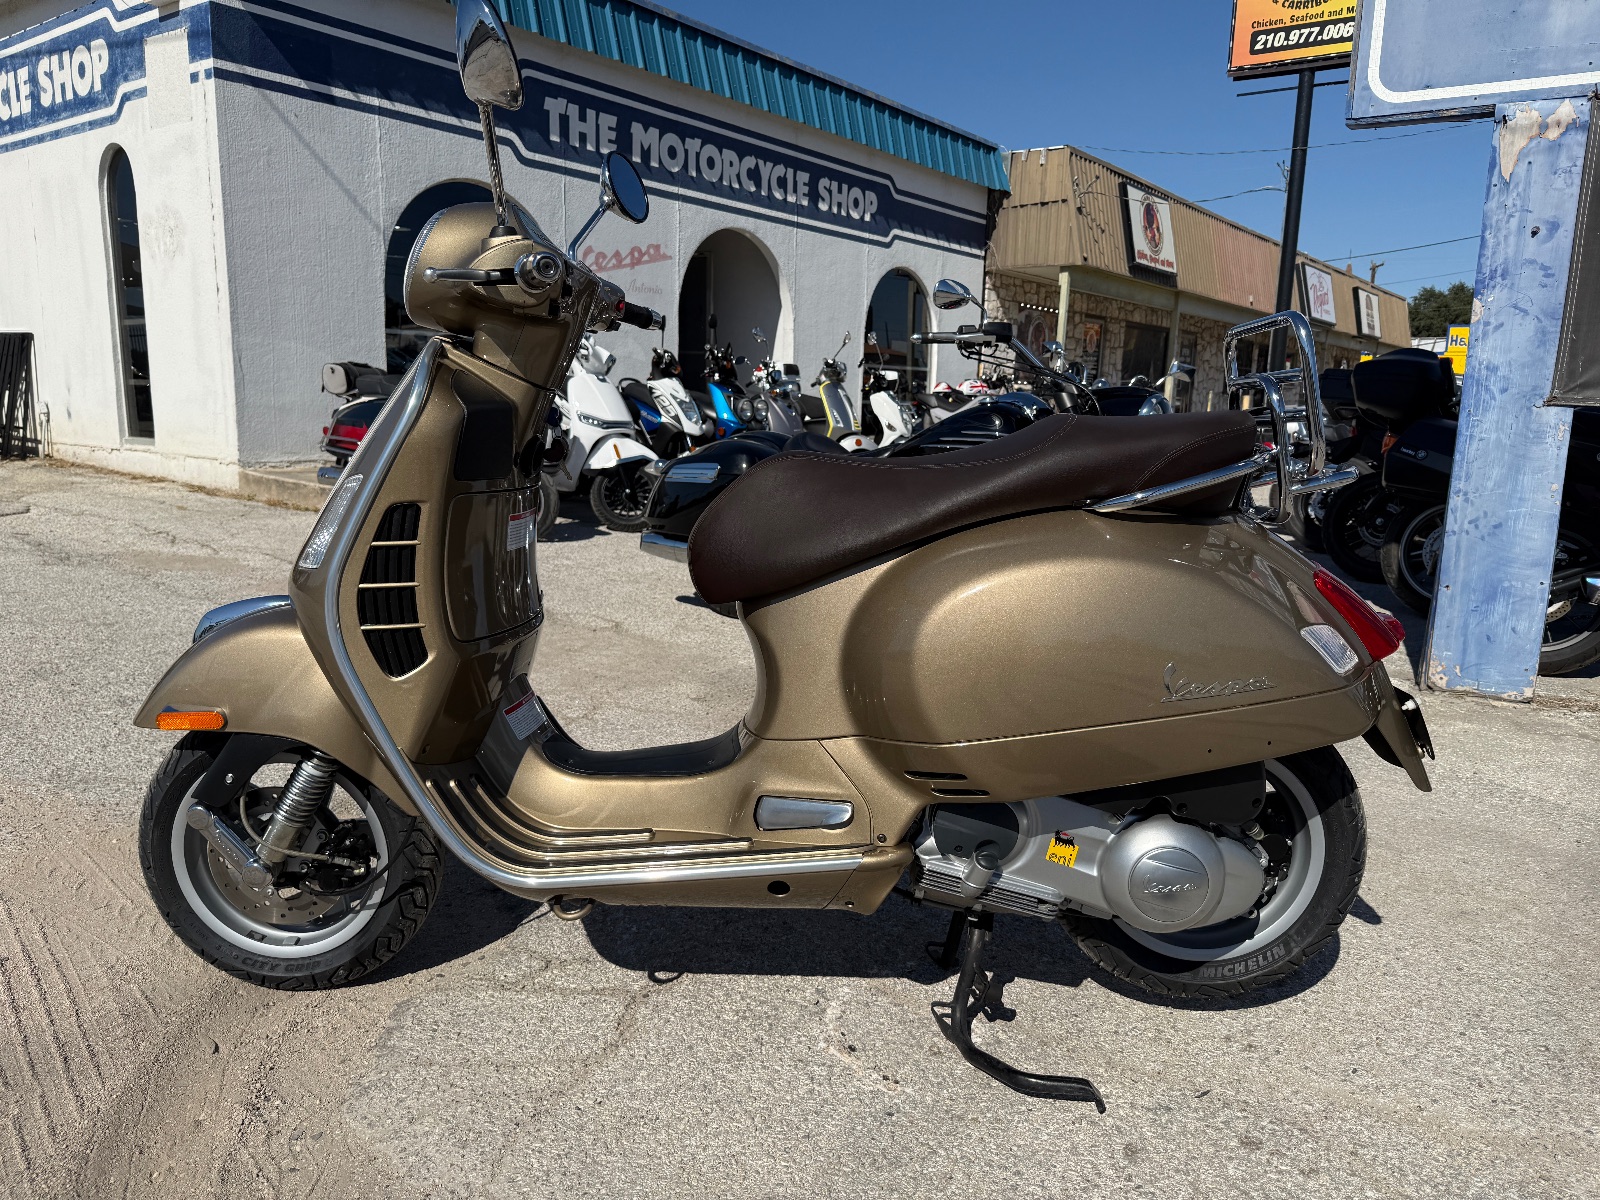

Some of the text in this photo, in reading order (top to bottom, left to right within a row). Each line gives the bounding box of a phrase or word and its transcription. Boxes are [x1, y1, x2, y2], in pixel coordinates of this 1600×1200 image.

[1251, 17, 1287, 29] Chicken,
[1289, 9, 1325, 24] Seafood
[1327, 8, 1344, 18] and
[1254, 21, 1356, 51] 210.977.006
[37, 38, 109, 108] SHOP
[544, 97, 878, 222] THE MOTORCYCLE SHOP
[625, 278, 663, 296] Antonio
[1160, 661, 1278, 703] Vespa
[1048, 852, 1073, 868] eni
[1199, 943, 1286, 978] MICHELIN
